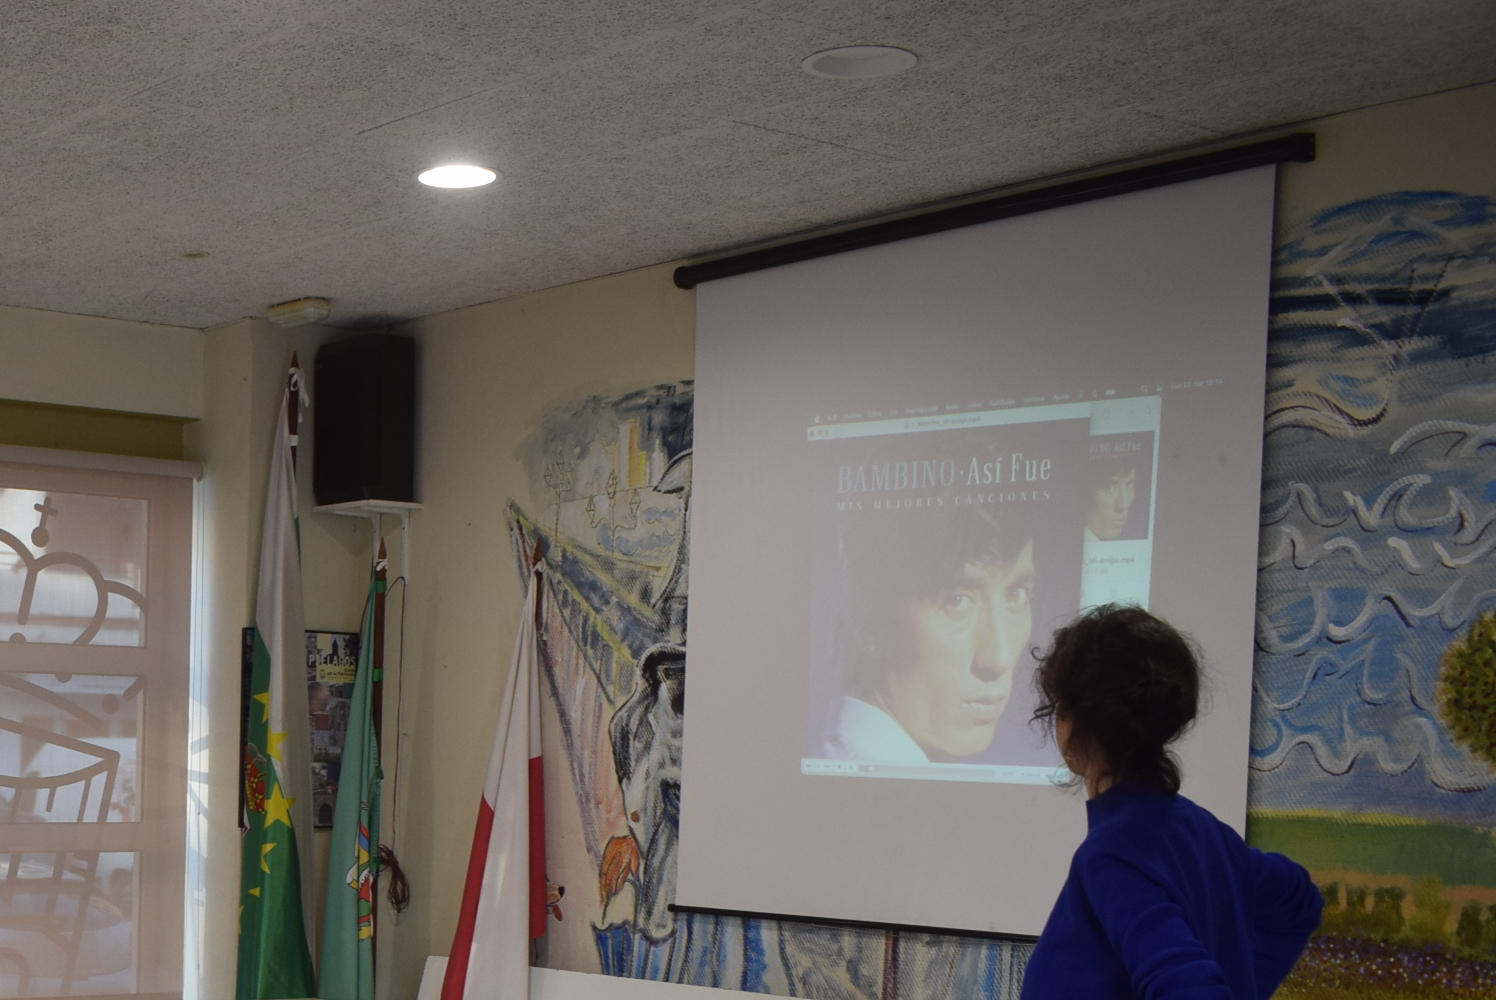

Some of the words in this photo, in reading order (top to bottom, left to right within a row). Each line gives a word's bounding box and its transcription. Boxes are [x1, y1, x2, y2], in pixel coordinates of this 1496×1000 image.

[838, 458, 956, 494] BAMBINO
[1010, 451, 1052, 484] Fue
[872, 496, 945, 511] MEJORES
[954, 490, 1052, 506] CANCIONES
